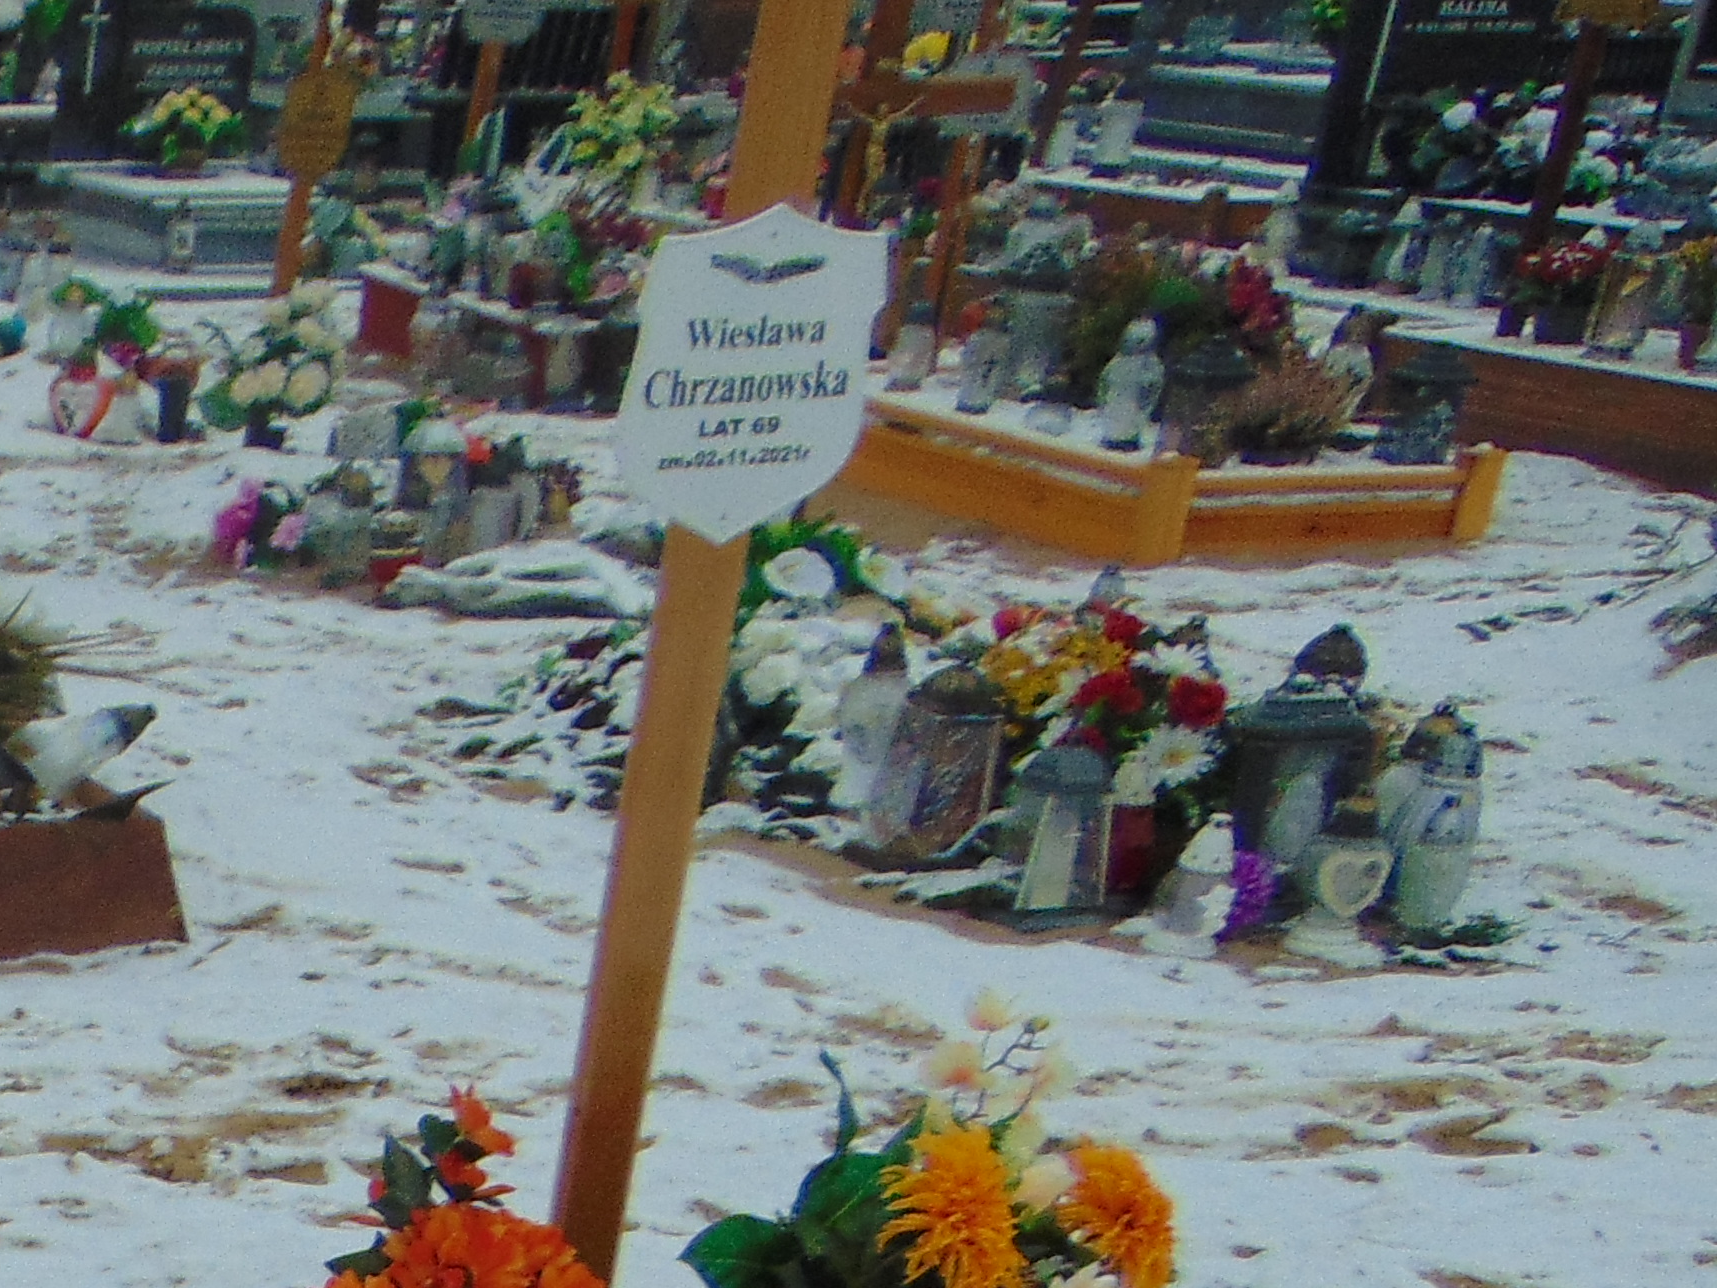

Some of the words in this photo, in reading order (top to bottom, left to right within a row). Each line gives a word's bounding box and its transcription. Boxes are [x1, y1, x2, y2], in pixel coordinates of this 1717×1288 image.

[688, 314, 827, 349] Wiesława
[644, 359, 850, 409] Chrzanowska
[698, 417, 745, 438] LAT
[751, 415, 782, 435] 69
